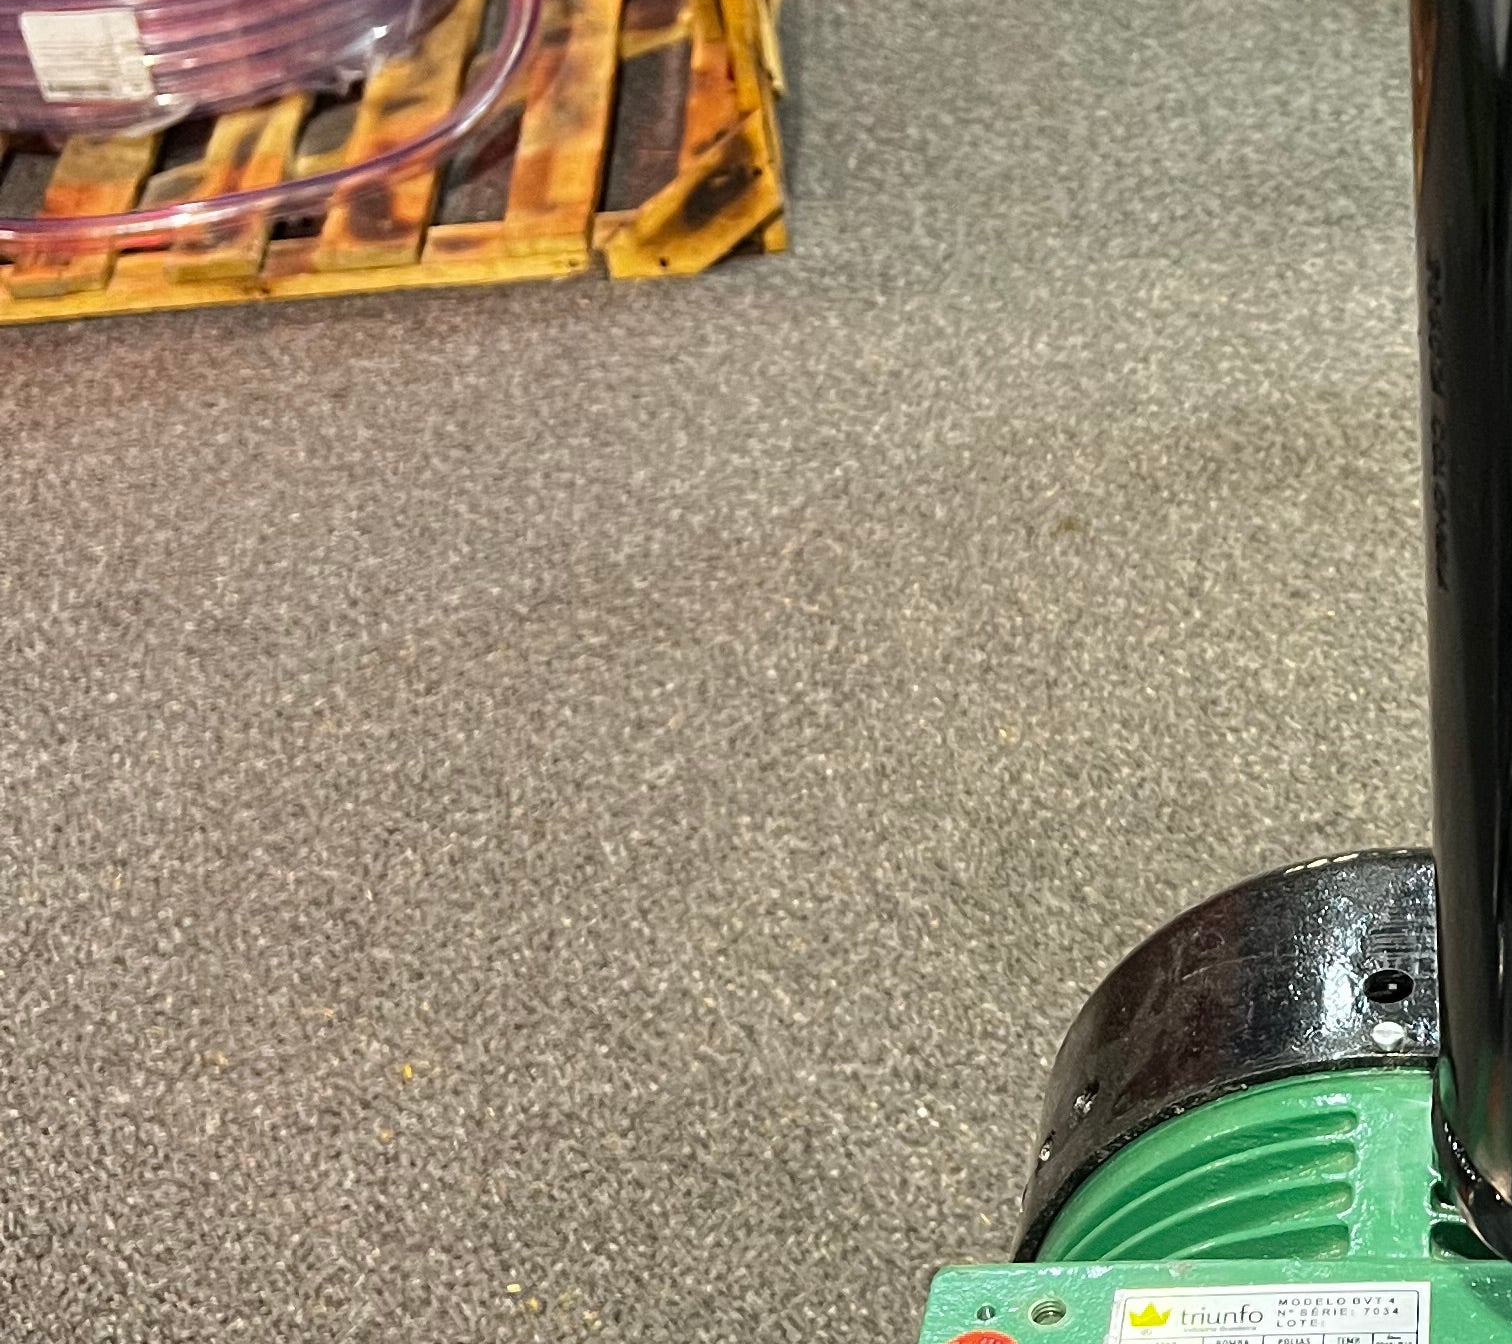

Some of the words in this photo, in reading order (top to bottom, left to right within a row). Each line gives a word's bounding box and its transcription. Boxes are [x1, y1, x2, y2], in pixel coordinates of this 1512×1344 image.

[1277, 1297, 1346, 1306] MODELO
[1352, 1296, 1382, 1305] BVT
[1180, 1303, 1264, 1326] triunfo
[1363, 1307, 1400, 1316] 7034
